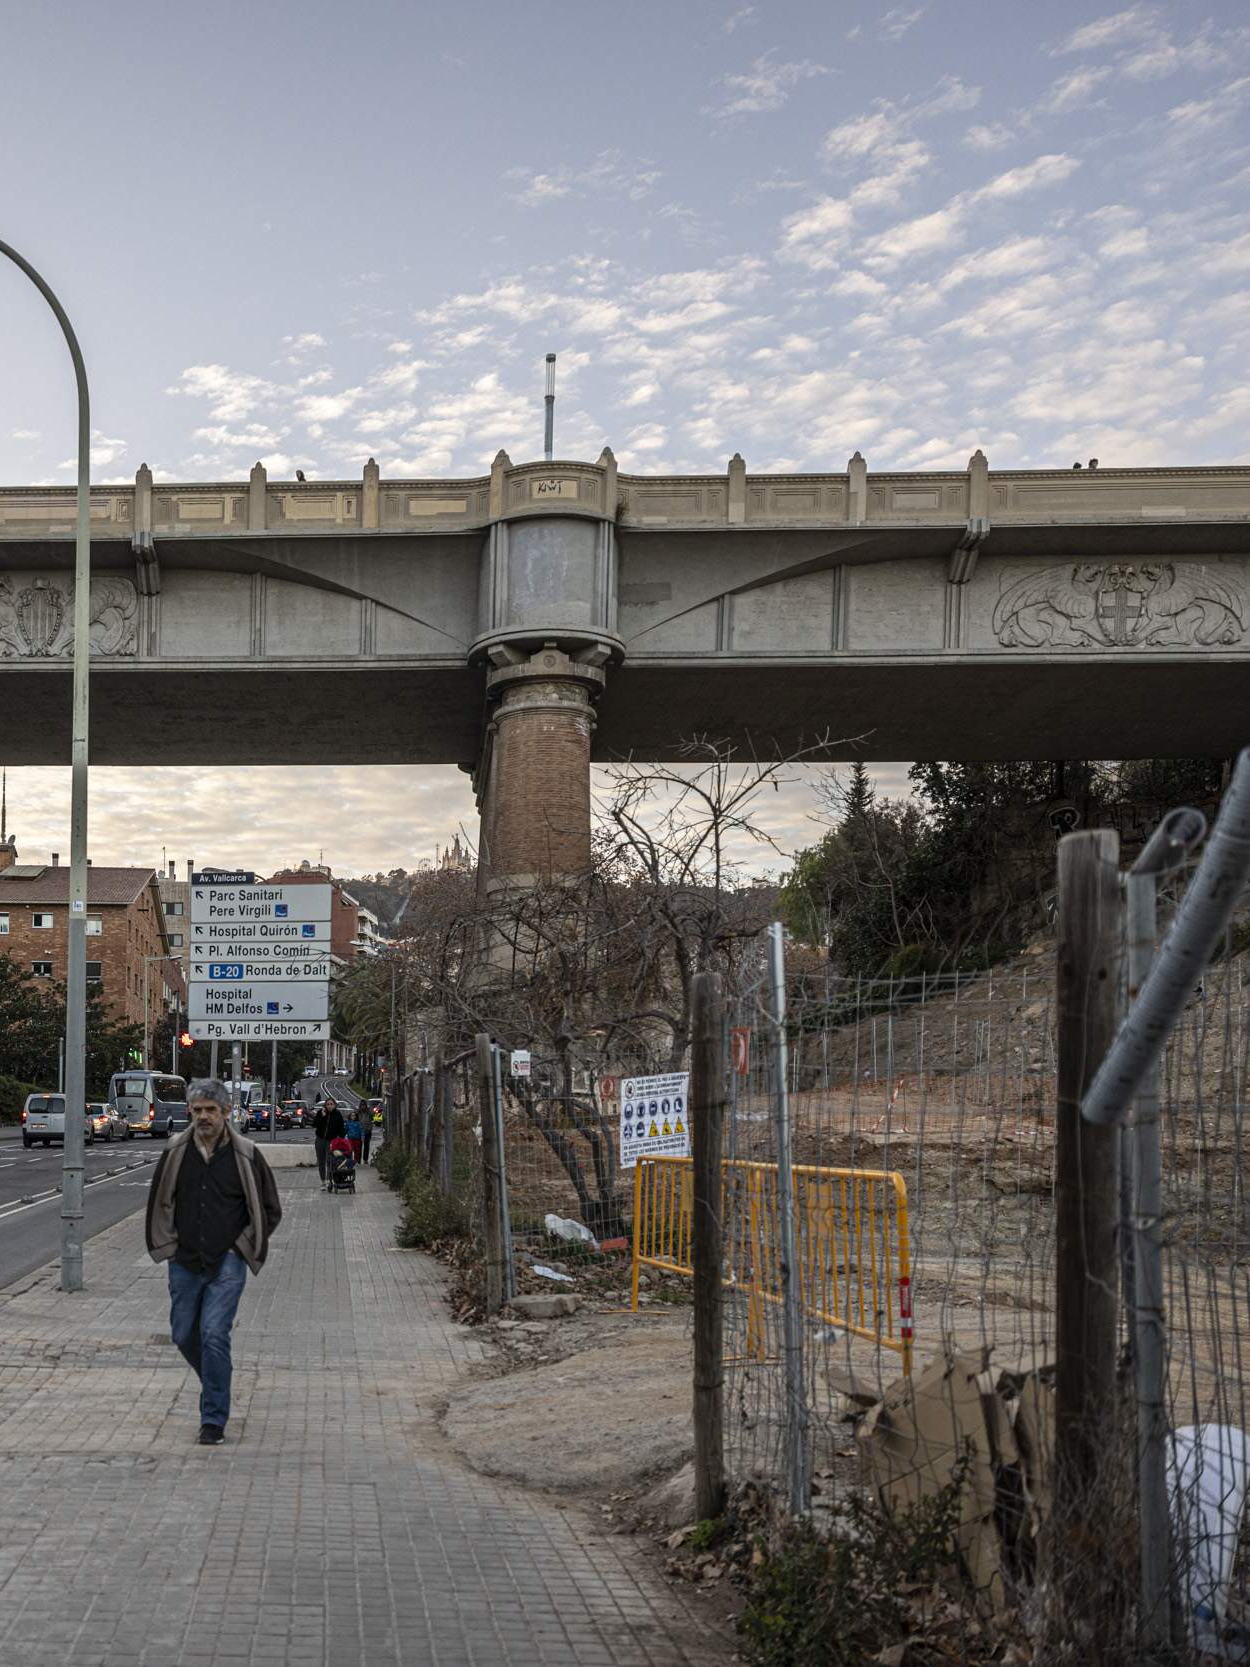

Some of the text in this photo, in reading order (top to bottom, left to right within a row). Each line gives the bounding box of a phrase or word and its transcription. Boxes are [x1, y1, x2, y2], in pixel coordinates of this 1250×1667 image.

[199, 873, 246, 882] Av. Vallcarca
[210, 889, 282, 901] Parc Sanitari
[210, 905, 271, 918] Pere Virgili
[210, 925, 297, 938] Hospital Quirón
[209, 945, 310, 956] Pl. Alfonso Comín
[214, 964, 327, 977] B-20 Ronda de Dalt
[206, 989, 252, 1001] Hospital
[206, 1002, 262, 1014] HM Delfos
[208, 1024, 306, 1036] Pg. Vall d'Hebron
